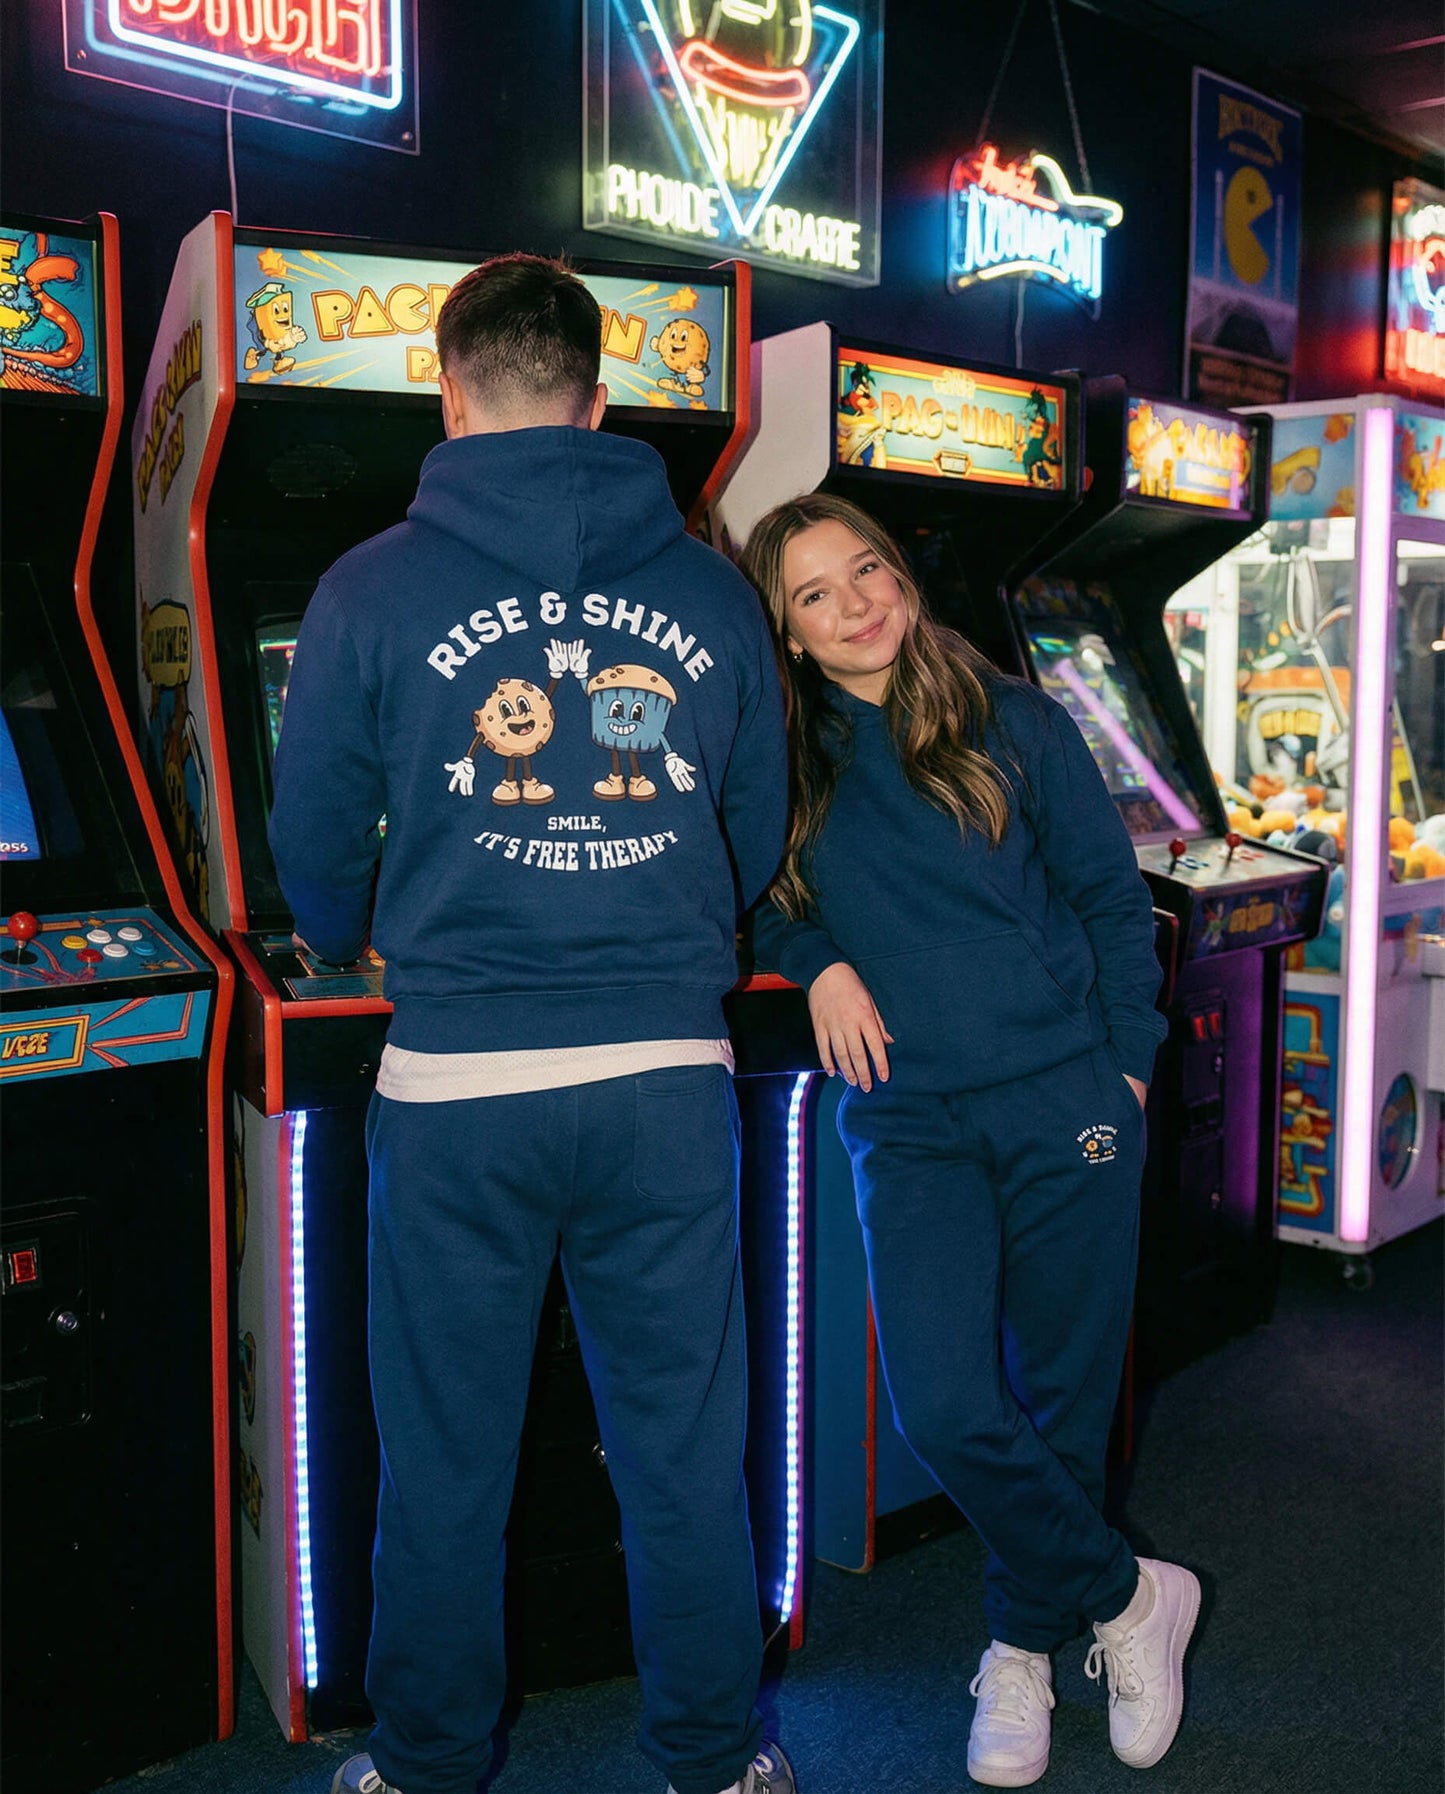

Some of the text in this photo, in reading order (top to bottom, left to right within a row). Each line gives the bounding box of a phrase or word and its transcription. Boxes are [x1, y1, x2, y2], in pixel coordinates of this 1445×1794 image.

[427, 592, 714, 682] RISE & SHINE
[547, 816, 607, 832] SMILE,
[473, 830, 679, 871] IT'S FREE THERAPY
